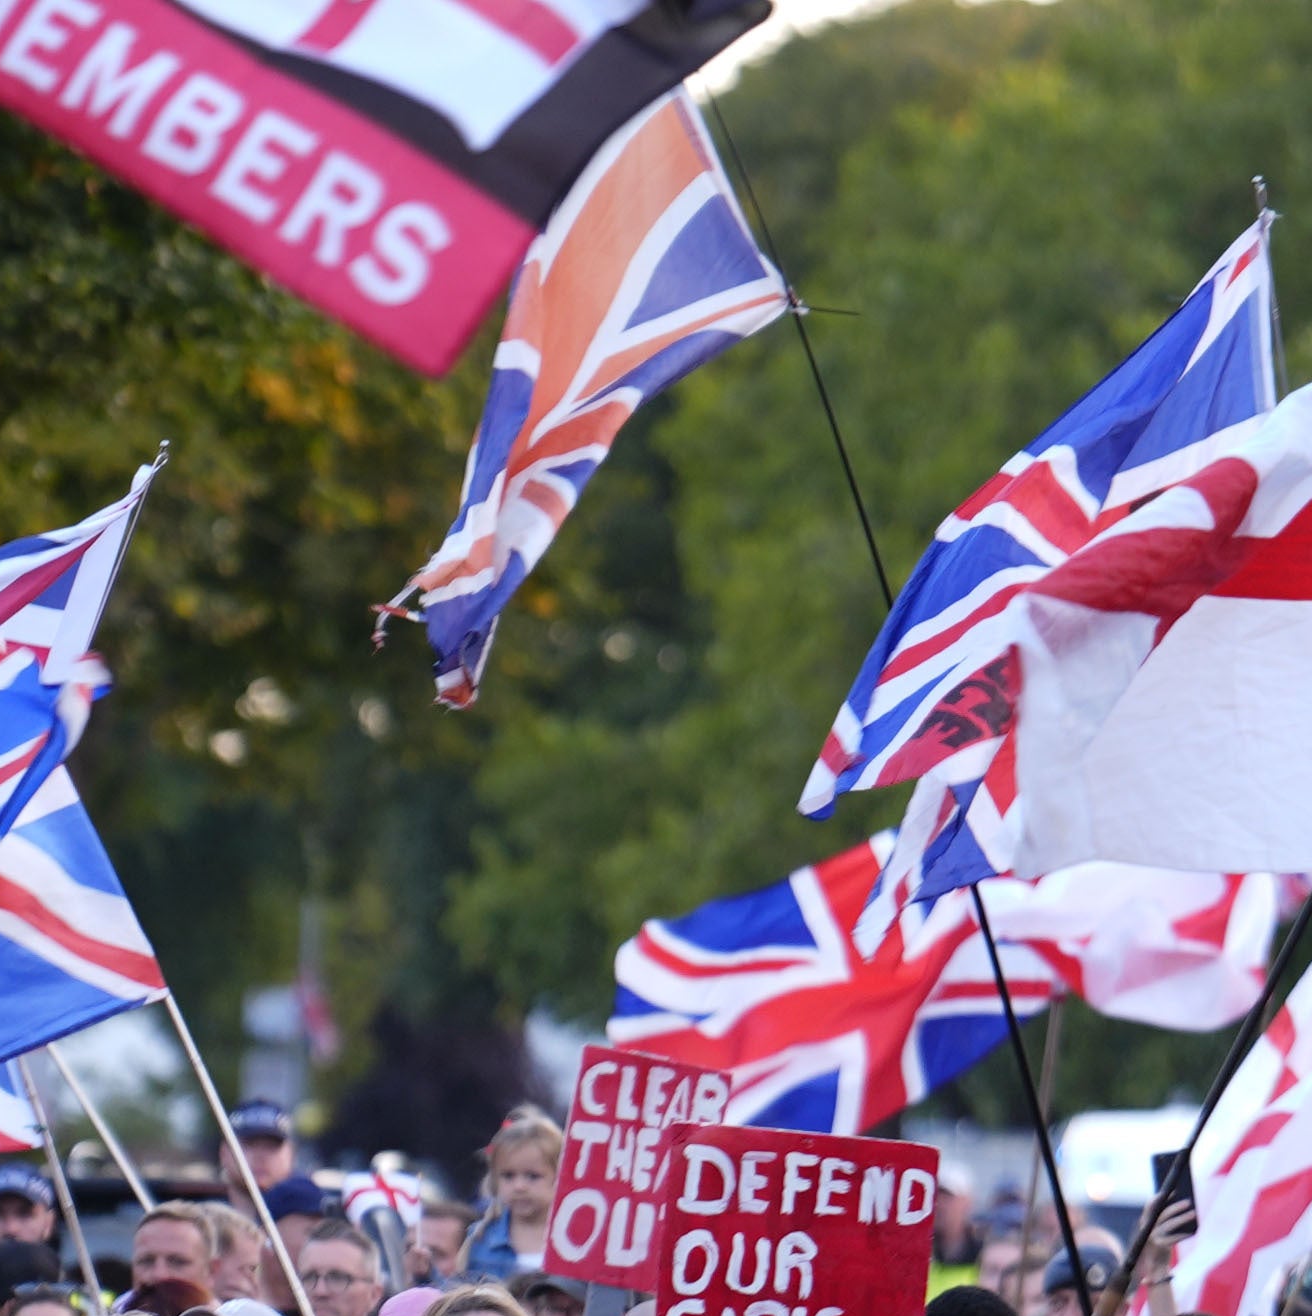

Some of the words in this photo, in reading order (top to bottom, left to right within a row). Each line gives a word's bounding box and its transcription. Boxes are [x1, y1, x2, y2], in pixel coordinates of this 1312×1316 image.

[580, 1061, 729, 1130] CLEAR
[569, 1120, 672, 1194] THE
[676, 1143, 935, 1226] DEFEND
[551, 1188, 667, 1267] OU
[672, 1228, 818, 1300] OUR
